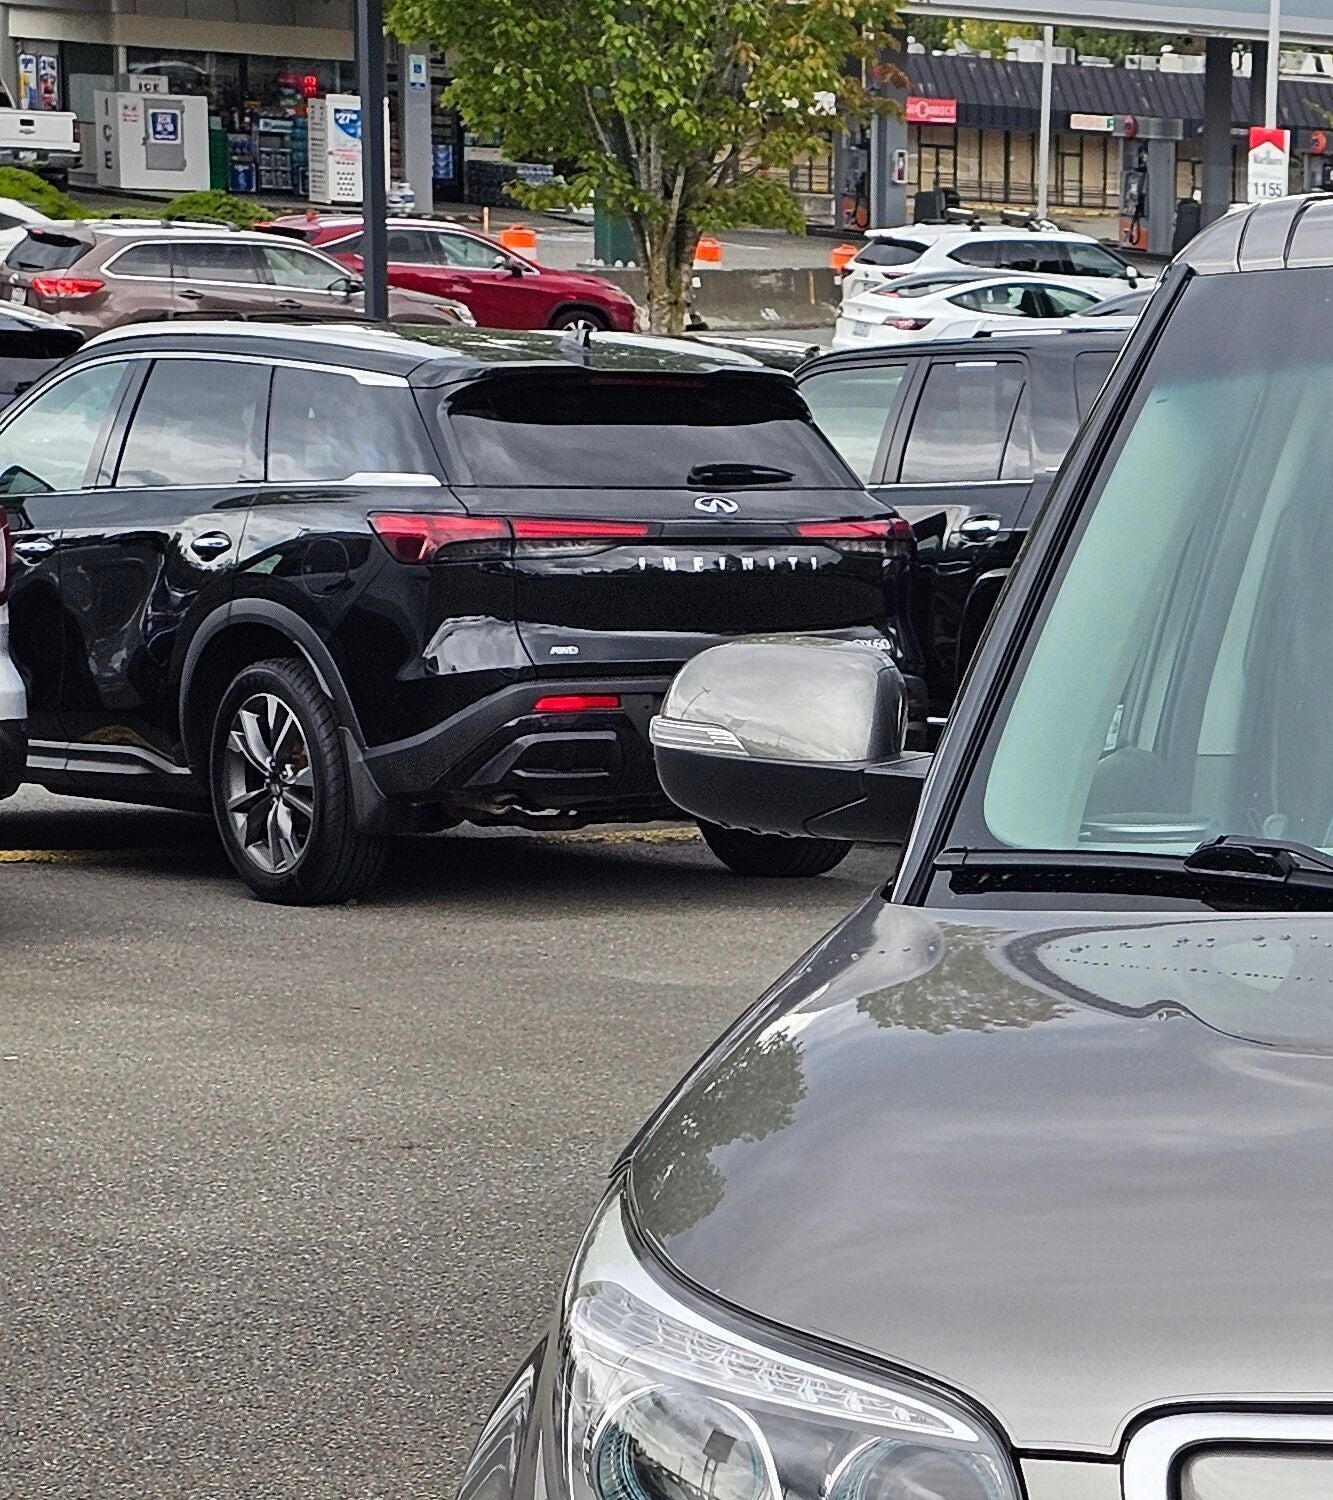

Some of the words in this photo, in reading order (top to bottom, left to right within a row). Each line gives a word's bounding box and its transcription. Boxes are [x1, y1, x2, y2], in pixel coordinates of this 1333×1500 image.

[102, 97, 114, 170] ICE
[1254, 182, 1283, 197] 1155
[638, 556, 817, 571] INFINITI
